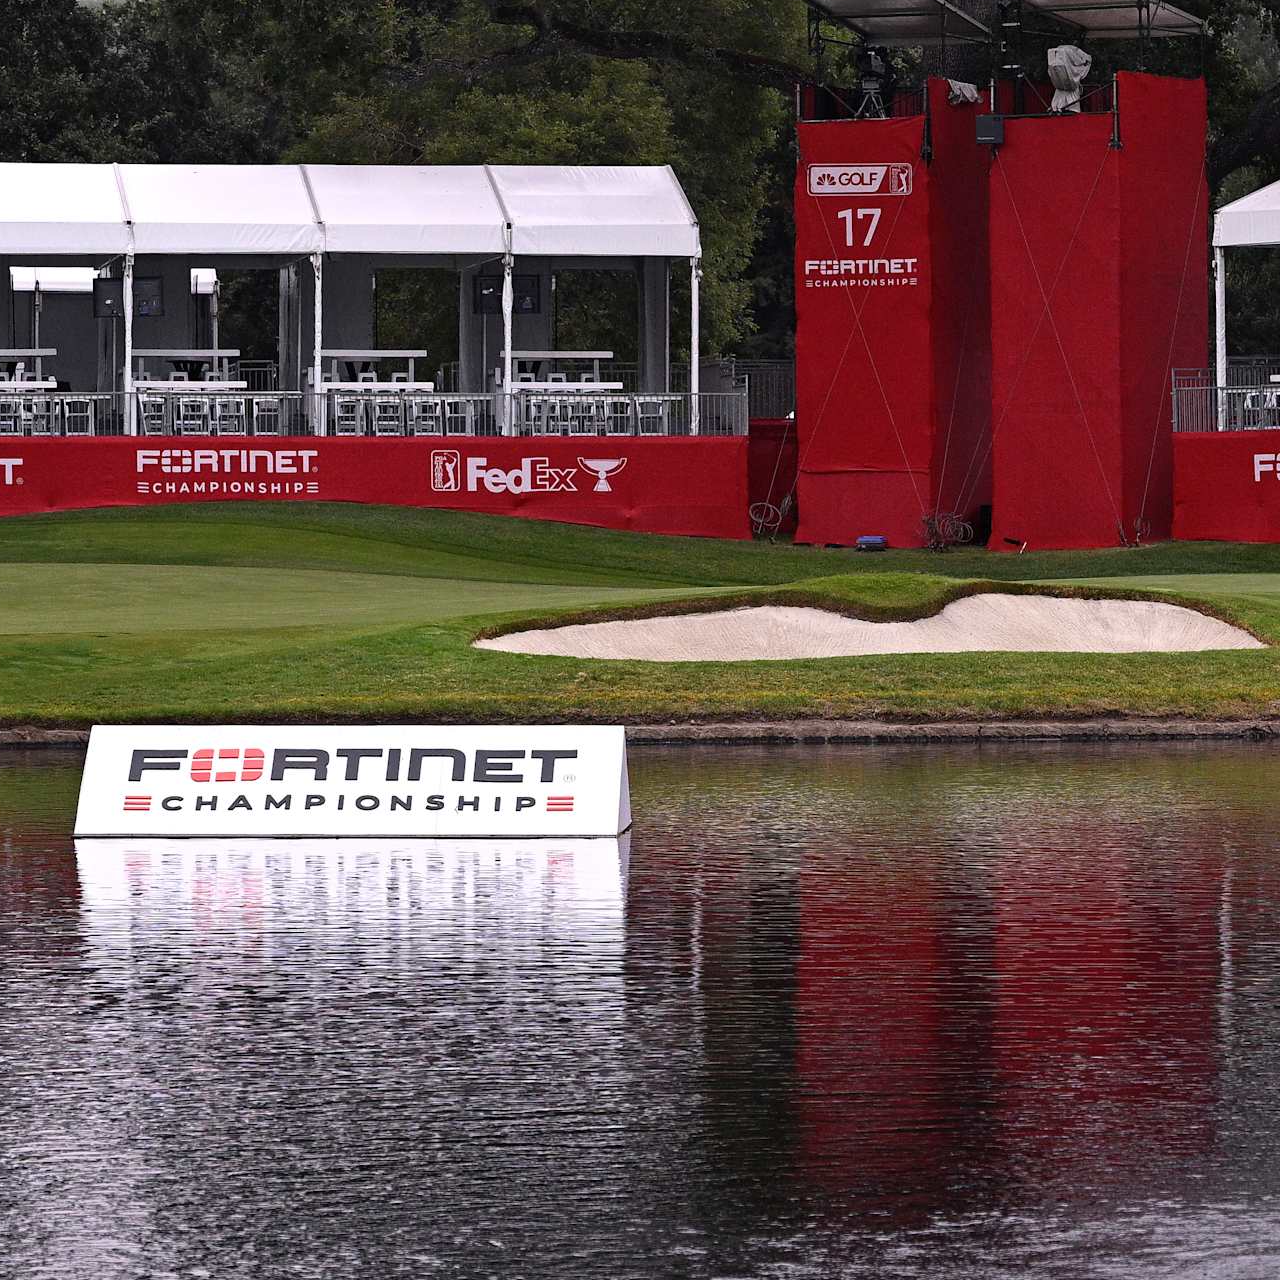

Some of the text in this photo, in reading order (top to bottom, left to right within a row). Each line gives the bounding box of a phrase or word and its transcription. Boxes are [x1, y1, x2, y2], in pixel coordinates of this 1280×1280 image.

[838, 172, 878, 186] GOLF
[837, 208, 882, 247] 17
[805, 258, 917, 275] FORTINET
[814, 278, 909, 288] CHAMPIONSHIP
[136, 449, 319, 473] FORTINET
[466, 457, 578, 494] FedEx
[152, 481, 304, 493] CHAMPIONSHIP
[128, 748, 578, 783] FORTINET
[161, 794, 536, 812] CHAMPIONSHIP
